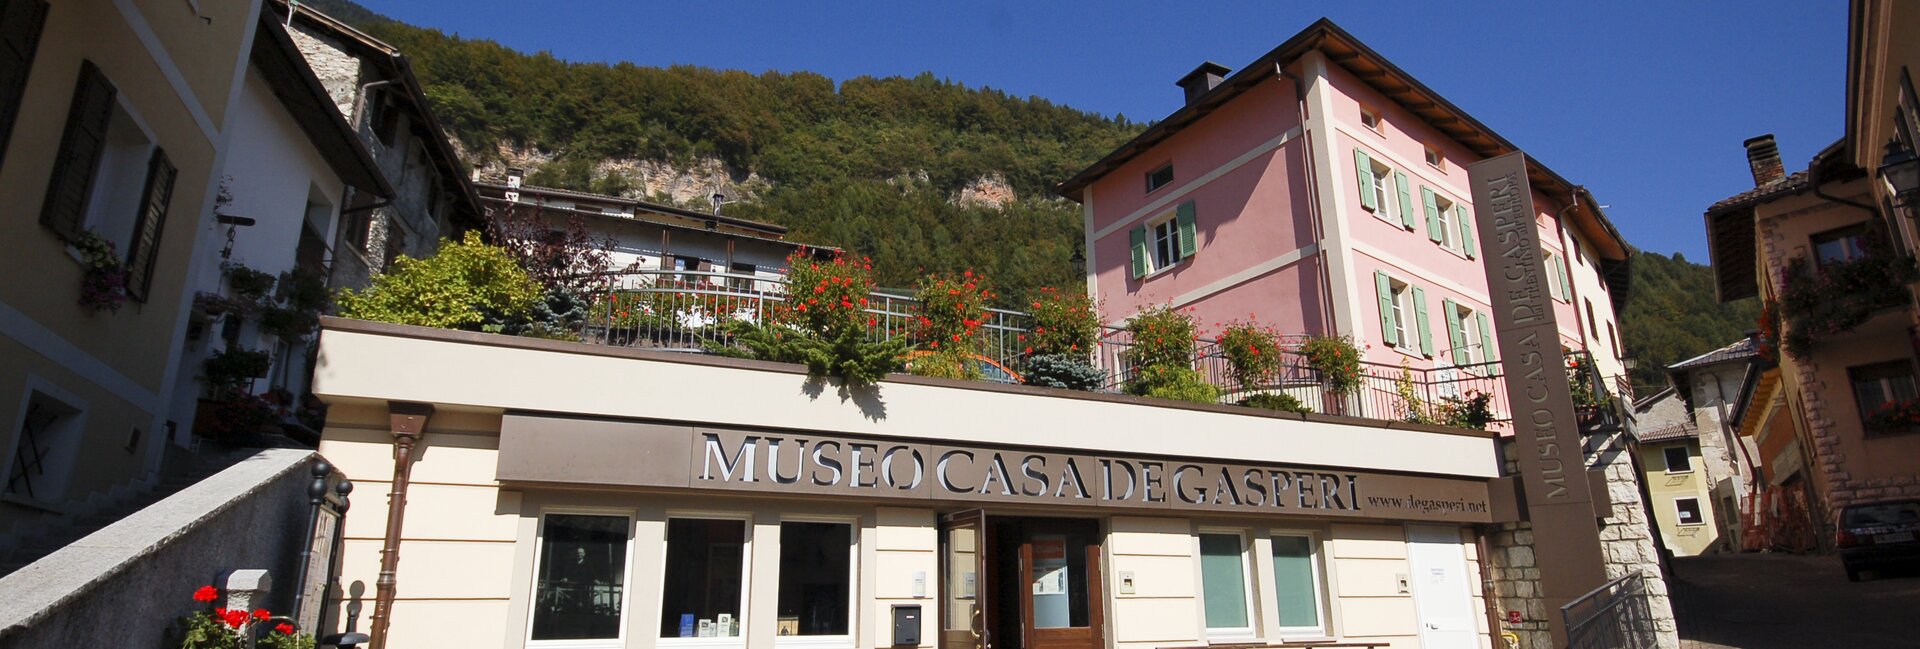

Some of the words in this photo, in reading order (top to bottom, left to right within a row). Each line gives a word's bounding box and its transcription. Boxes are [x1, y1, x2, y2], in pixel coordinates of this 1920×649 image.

[1488, 173, 1526, 281] GASPERI
[1508, 288, 1535, 324] DE
[1519, 238, 1542, 303] TRENTINO
[1518, 330, 1550, 403] CASA
[698, 432, 925, 490] MUSEO
[936, 449, 1092, 500] CASA
[1098, 459, 1166, 503] DE
[1173, 464, 1361, 511] GASPERI
[1531, 408, 1569, 499] MUSEO
